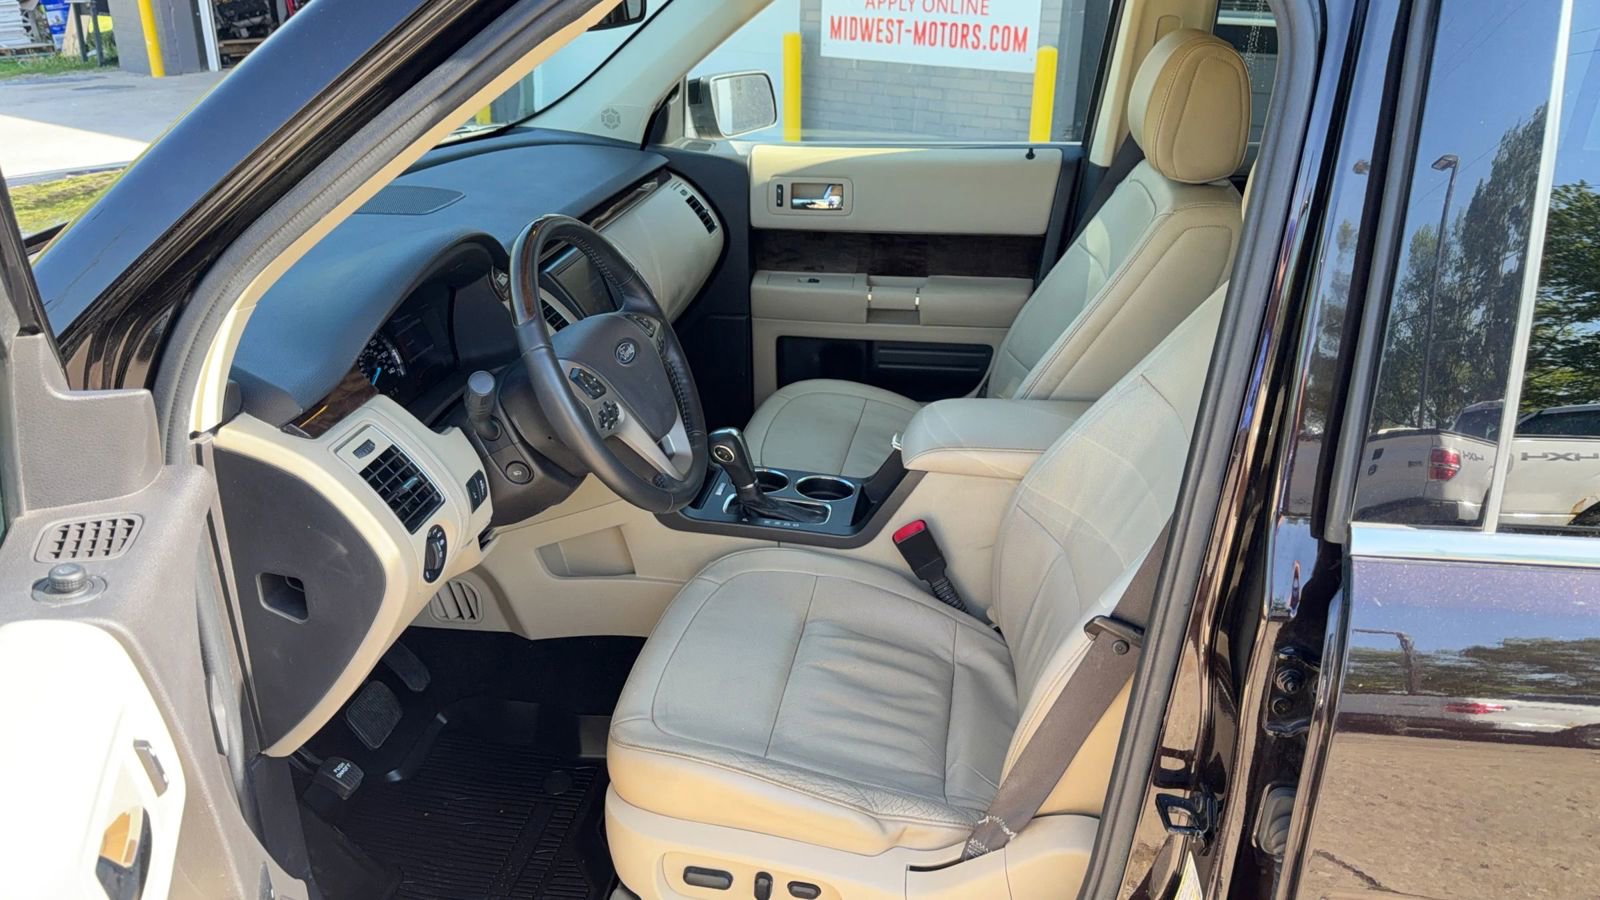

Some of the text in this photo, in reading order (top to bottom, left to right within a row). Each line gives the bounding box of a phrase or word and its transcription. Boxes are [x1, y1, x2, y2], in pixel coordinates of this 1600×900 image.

[865, 0, 989, 15] APPLY ONLINE
[830, 15, 1028, 53] MIDWEST-MOTORS.COM
